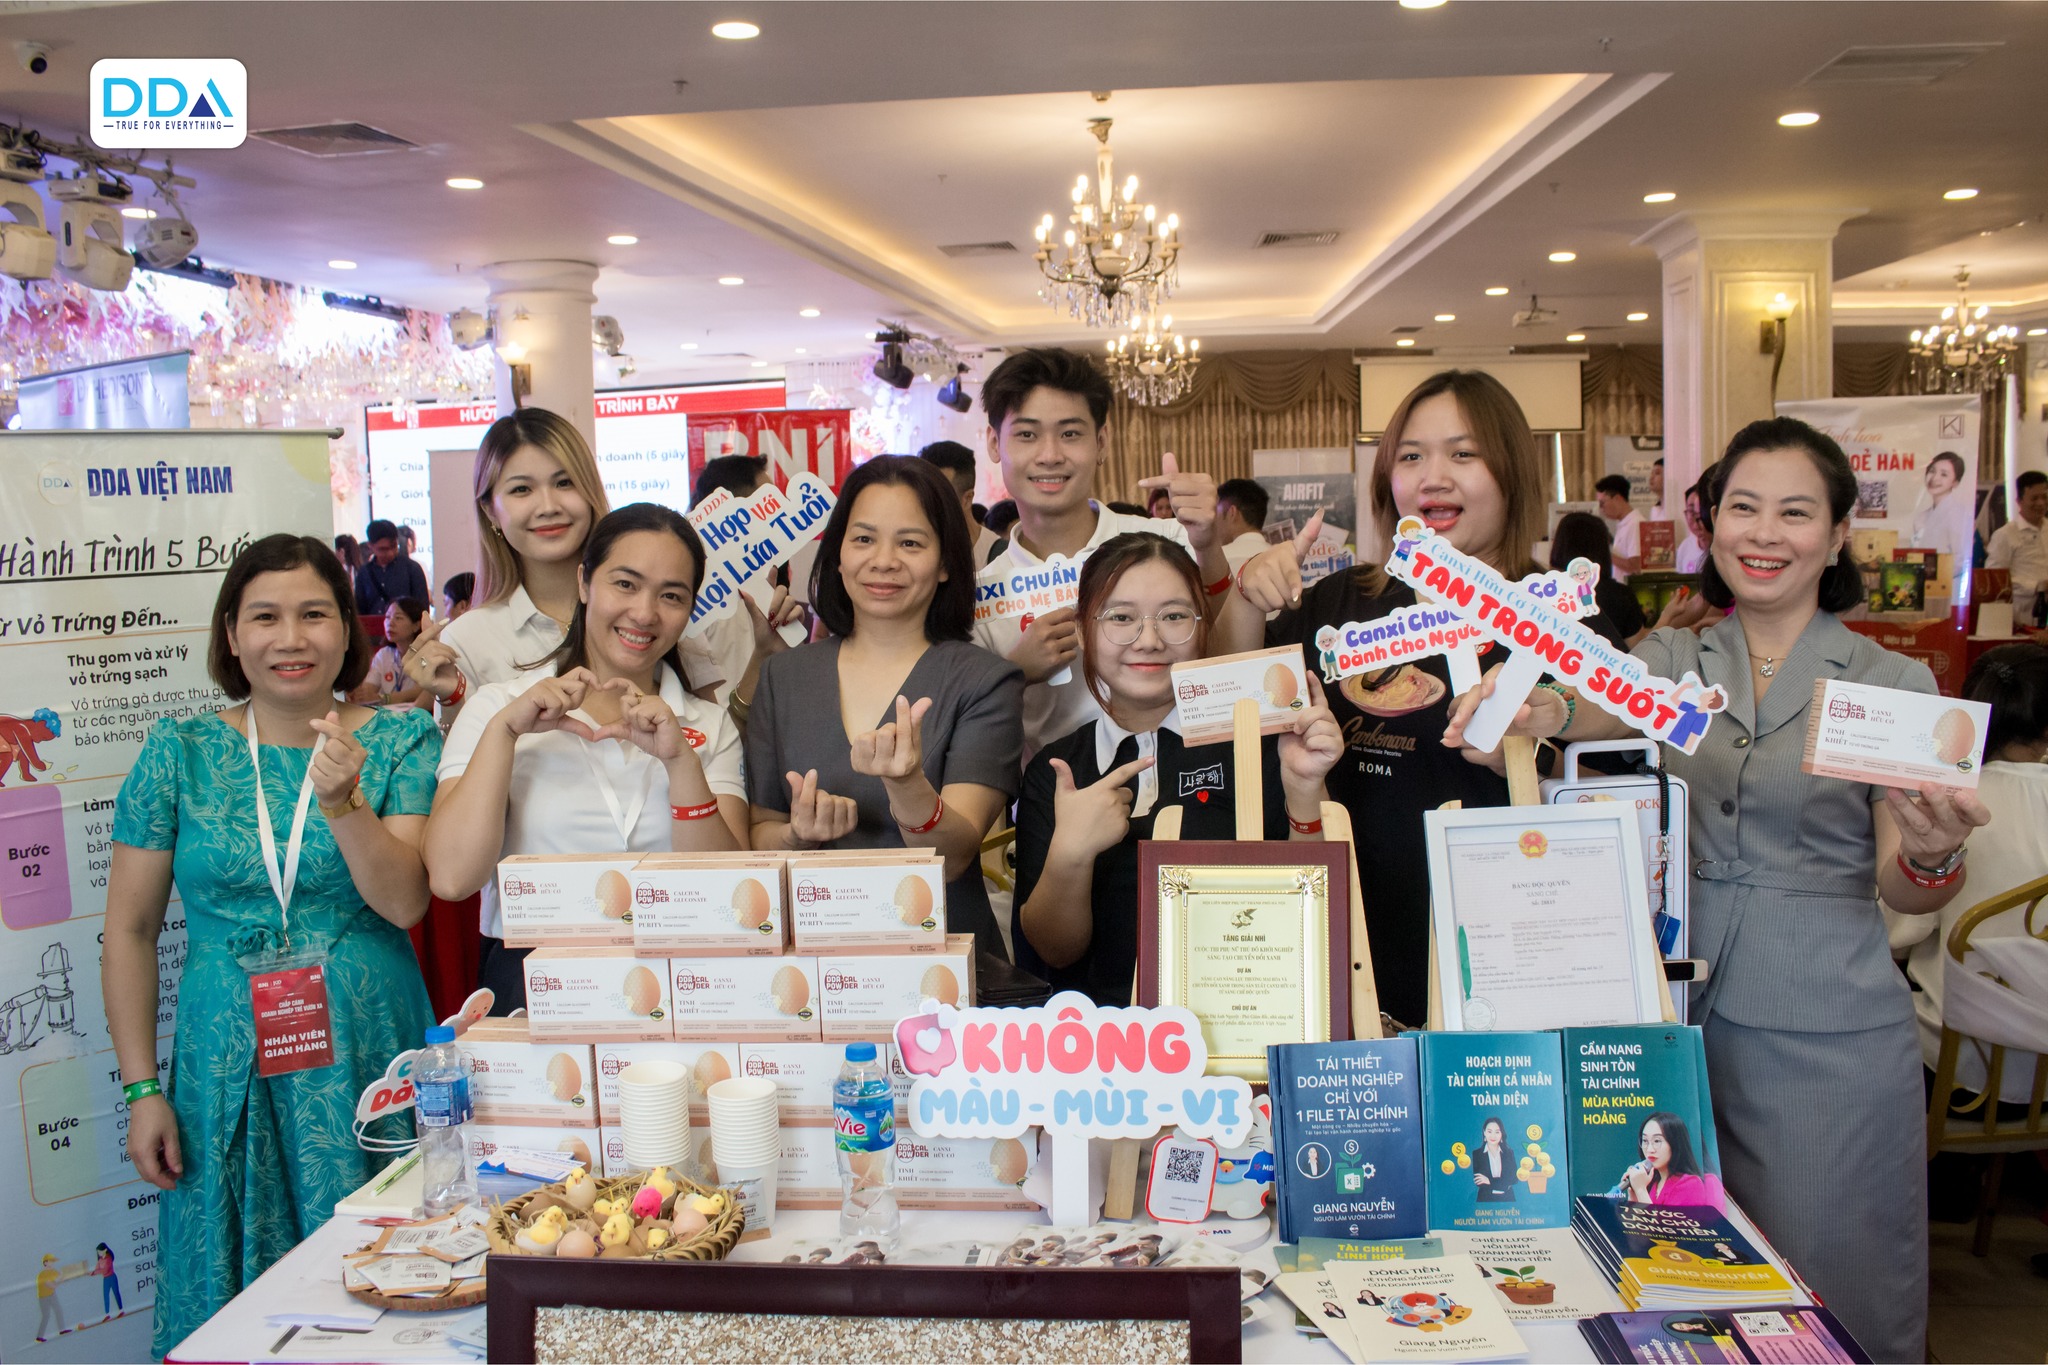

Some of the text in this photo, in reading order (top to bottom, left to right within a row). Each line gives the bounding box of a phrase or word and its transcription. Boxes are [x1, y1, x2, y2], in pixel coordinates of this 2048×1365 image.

[597, 394, 679, 414] TRÌNH BÀY
[606, 452, 643, 462] doanh
[1877, 450, 1915, 471] HÀN
[400, 463, 424, 472] Chia
[87, 460, 233, 501] DDA VIỆT NAM
[401, 489, 424, 499] Giới
[1283, 482, 1326, 500] AIRFIT
[703, 493, 729, 515] DDA
[699, 494, 782, 551] Hợp Với
[723, 538, 780, 585] Lứa
[769, 482, 832, 542] Tuổi
[0, 536, 73, 578] Hành
[84, 533, 155, 573] Trình
[167, 539, 183, 568] 5
[1011, 561, 1077, 594] CHUẨN
[995, 593, 1052, 615] CHO MẸ
[1431, 544, 1641, 682] Canxi Hữu Cơ Từ Vỏ Trứng Gà
[17, 613, 45, 636] Vỏ
[52, 611, 116, 635] Trứng
[1346, 616, 1405, 648] Canxi
[1411, 551, 1678, 731] TAN TRONG SUỐT
[67, 645, 188, 668] Thu gom và xử lý
[1339, 638, 1427, 670] Dành Cho
[69, 666, 168, 686] vỏ trứng sạch
[71, 686, 209, 712] Vỏ trứng gà được thu
[73, 714, 88, 729] từ
[90, 712, 116, 727] các
[119, 709, 161, 726] nguồn
[75, 728, 145, 747] bảo không
[1359, 761, 1392, 776] ROMA
[1185, 770, 1219, 788] 사랑해
[85, 824, 102, 836] Vỏ
[8, 844, 50, 861] Bước
[22, 864, 41, 878] 02
[88, 858, 111, 873] loại
[263, 1029, 326, 1047] NHÂN VIÊN
[962, 1006, 1191, 1075] KHÔNG
[264, 1040, 327, 1058] GIAN HÀNG
[1580, 1041, 1642, 1055] CẨM NANG
[1316, 1050, 1382, 1071] TÁI THIẾT
[1465, 1055, 1531, 1070] HOẠCH ĐỊNH
[1581, 1057, 1635, 1072] SINH TỒN
[1297, 1071, 1404, 1089] DOANH NGHIỆP
[1447, 1072, 1552, 1087] TÀI CHÍNH CÁ NHÂN
[1581, 1076, 1640, 1089] TÀI CHÍNH
[1324, 1088, 1378, 1104] CHỈ VỚI
[1471, 1093, 1529, 1107] TOÀN DIỆN
[1582, 1094, 1654, 1108] MÙA KHỦNG
[919, 1077, 1240, 1135] MÀU MÙI VỊ
[1296, 1103, 1408, 1122] 1 FILE TÀI CHÍNH
[38, 1115, 80, 1136] Bước
[1583, 1112, 1626, 1125] HOẢNG
[50, 1136, 71, 1151] 04
[1313, 1197, 1395, 1214] GIANG NGUYỄN
[1620, 1205, 1686, 1219] 7 BƯỚC
[1621, 1213, 1701, 1228] LÀM CHỦ
[1622, 1221, 1719, 1237] DÒNG TIỀN
[131, 1226, 155, 1242] Sản
